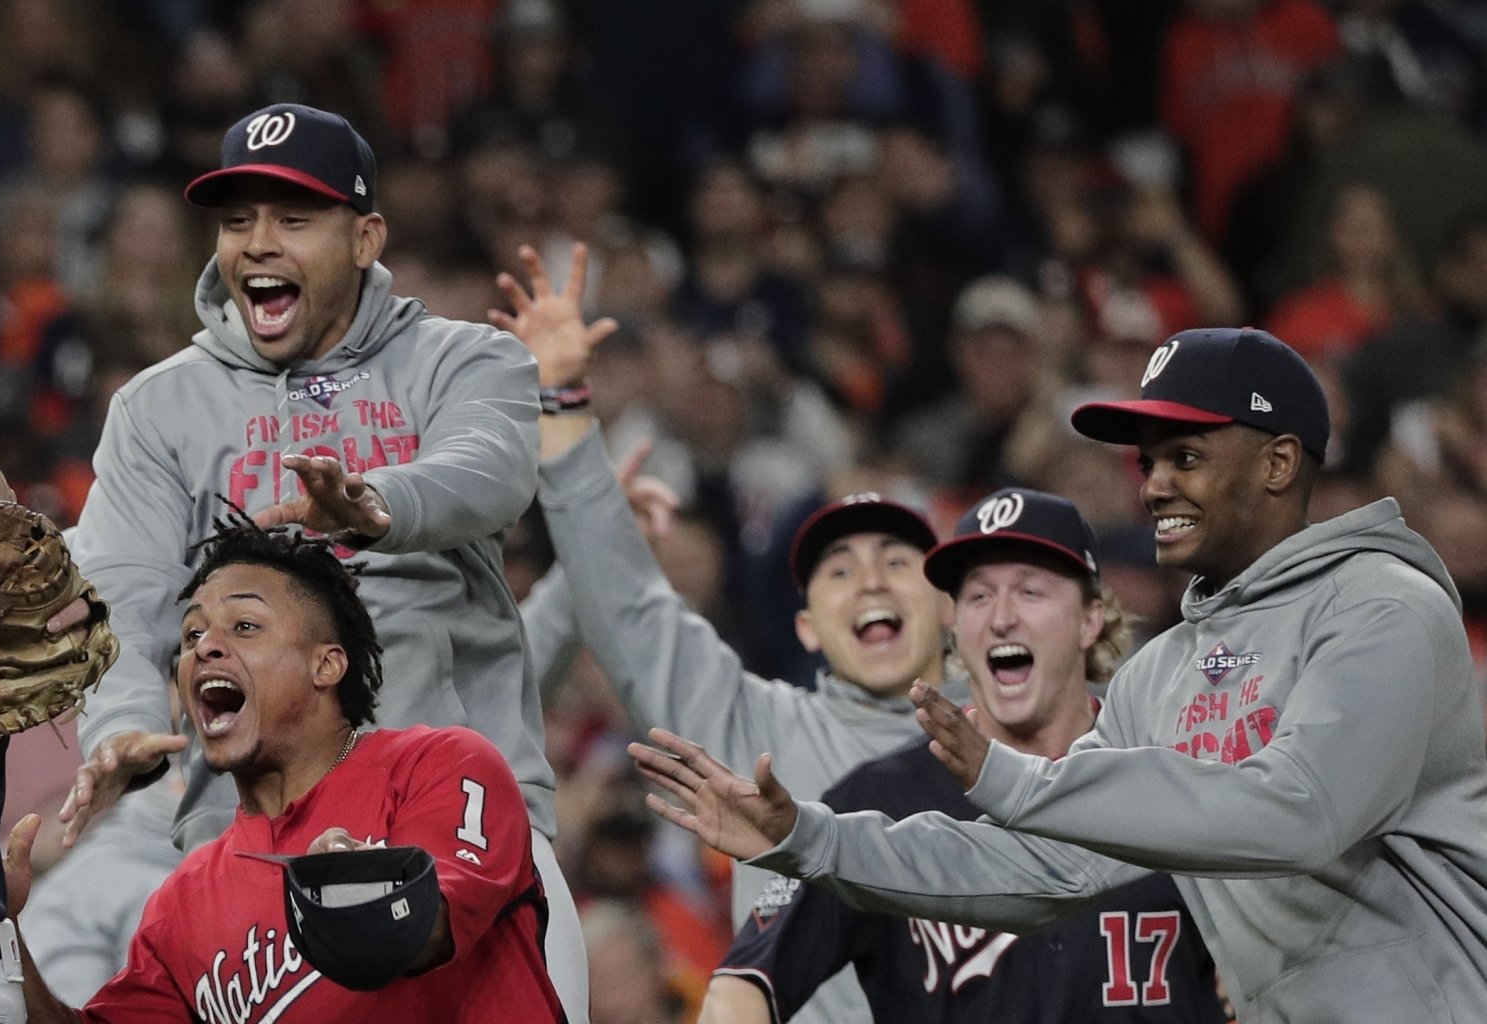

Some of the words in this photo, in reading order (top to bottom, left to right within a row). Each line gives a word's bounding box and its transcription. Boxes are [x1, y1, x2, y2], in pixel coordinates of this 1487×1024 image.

[246, 112, 296, 151] W
[976, 493, 1024, 535] W
[1239, 674, 1264, 708] HE
[456, 778, 488, 851] 1
[1099, 910, 1181, 1007] 17
